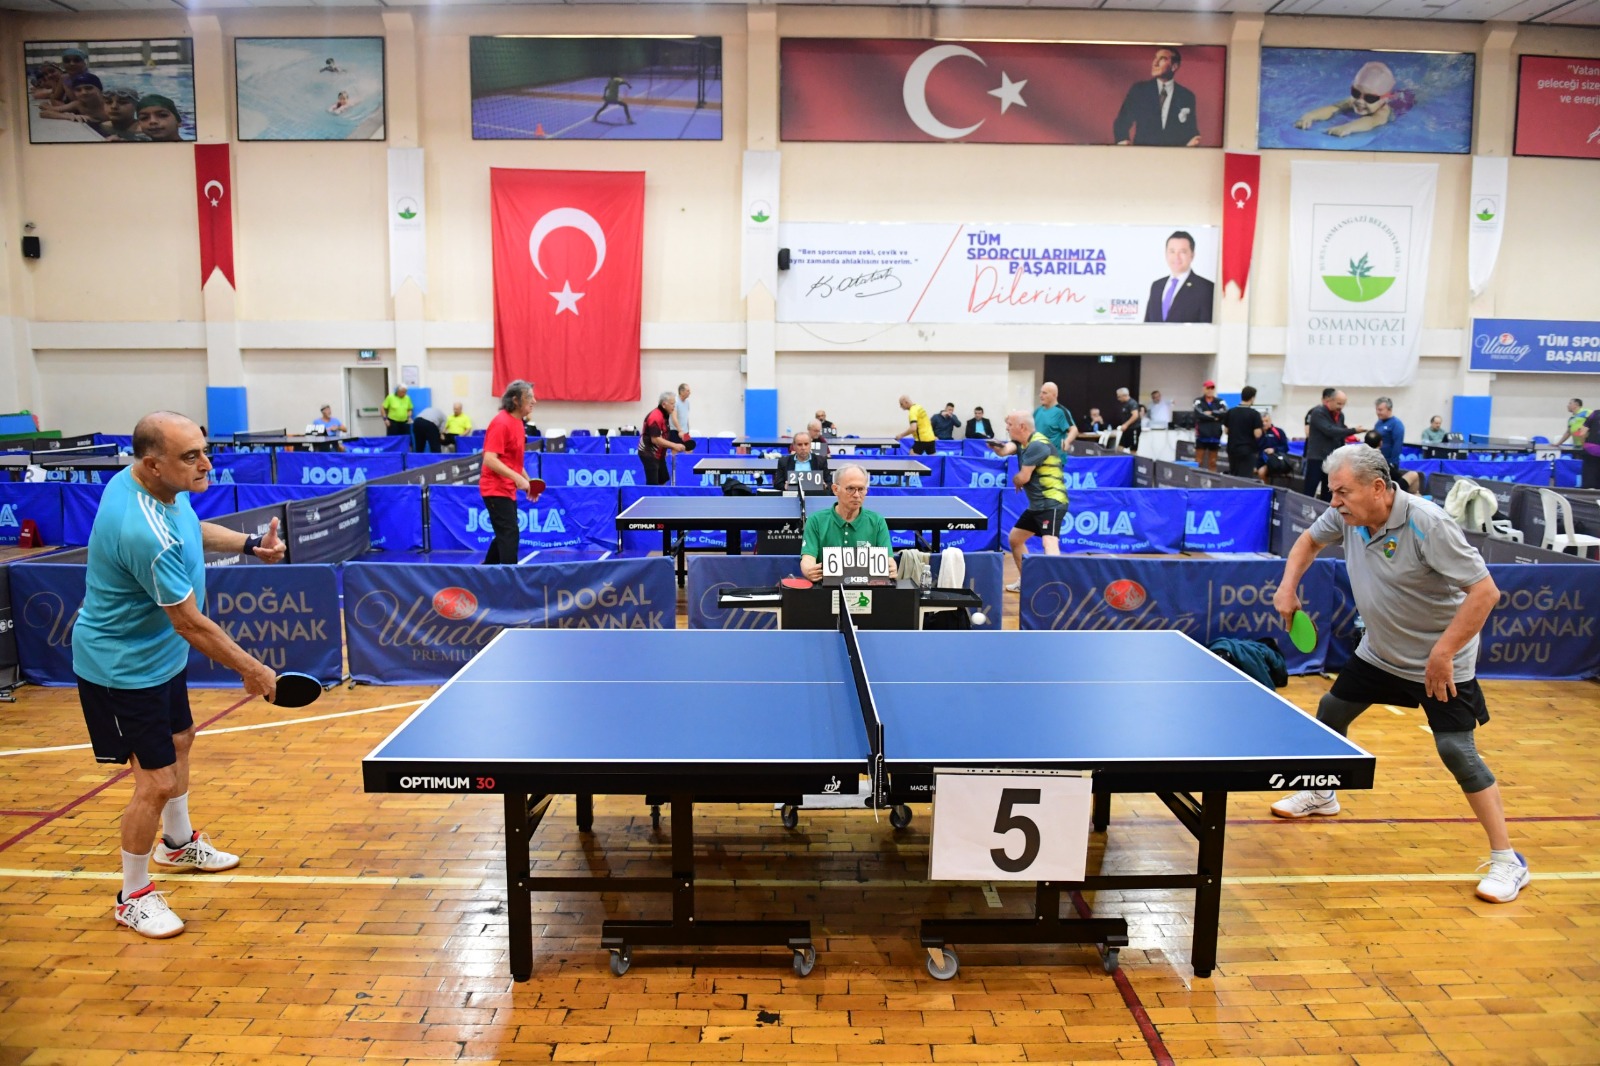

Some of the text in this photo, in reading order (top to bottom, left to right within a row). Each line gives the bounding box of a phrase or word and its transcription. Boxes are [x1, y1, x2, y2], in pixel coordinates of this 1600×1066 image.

[1537, 78, 1580, 91] geleceği
[1560, 95, 1572, 103] ve
[967, 231, 1001, 246] TÜM
[817, 249, 857, 257] sporcunun
[967, 248, 1106, 261] SPORCULARIMIZA
[1009, 261, 1106, 277] BAŞARILAR
[967, 264, 1086, 313] Dilerim
[1308, 317, 1406, 332] OSMANGAZİ
[1308, 334, 1406, 346] BELEDİYESİ
[1475, 334, 1532, 362] Uludağ
[1537, 333, 1600, 347] TÜM SPO
[302, 467, 367, 485] JOOLA
[567, 468, 637, 487] JOOLA
[789, 473, 797, 484] 2
[814, 473, 822, 485] 0
[969, 472, 1008, 488] JOO
[1063, 472, 1098, 488] OLA
[1059, 511, 1135, 535] OOLA
[519, 539, 552, 549] ampion
[1077, 537, 1119, 550] Champion
[1131, 540, 1150, 552] you!
[828, 551, 887, 574] 6 0 0 10
[217, 587, 313, 614] DOĞAL
[557, 581, 652, 612] DOĞAL
[1219, 579, 1310, 606] DOĞL
[1494, 585, 1585, 611] DOĞAL
[355, 590, 531, 647] Uluda
[558, 611, 664, 629] KAYNAK
[1491, 615, 1594, 637] KAYNAK
[220, 619, 328, 642] KAYNAK
[1488, 642, 1551, 663] SUYU
[400, 776, 496, 790] OPTIMUM 30
[1289, 775, 1342, 787] STIGA
[989, 788, 1042, 873] 5
